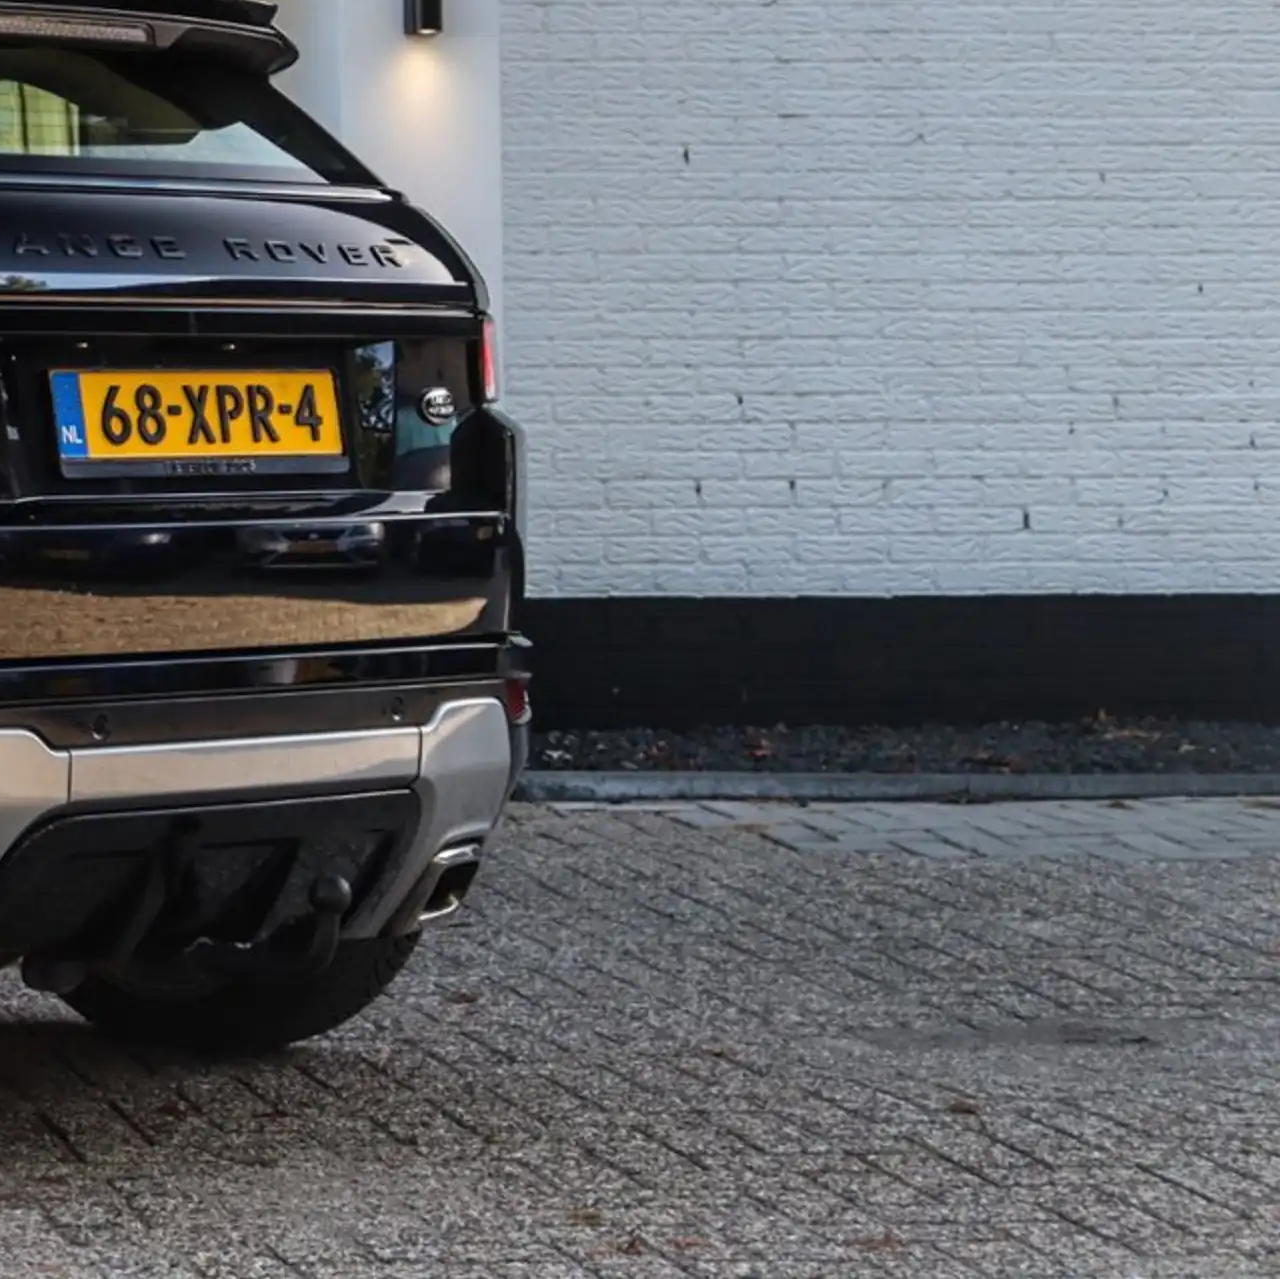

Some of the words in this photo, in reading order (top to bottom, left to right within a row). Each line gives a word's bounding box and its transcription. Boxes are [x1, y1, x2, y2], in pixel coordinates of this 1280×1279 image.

[223, 237, 403, 268] ROVER
[101, 383, 323, 446] 68-XPR-4
[61, 425, 83, 444] NL
